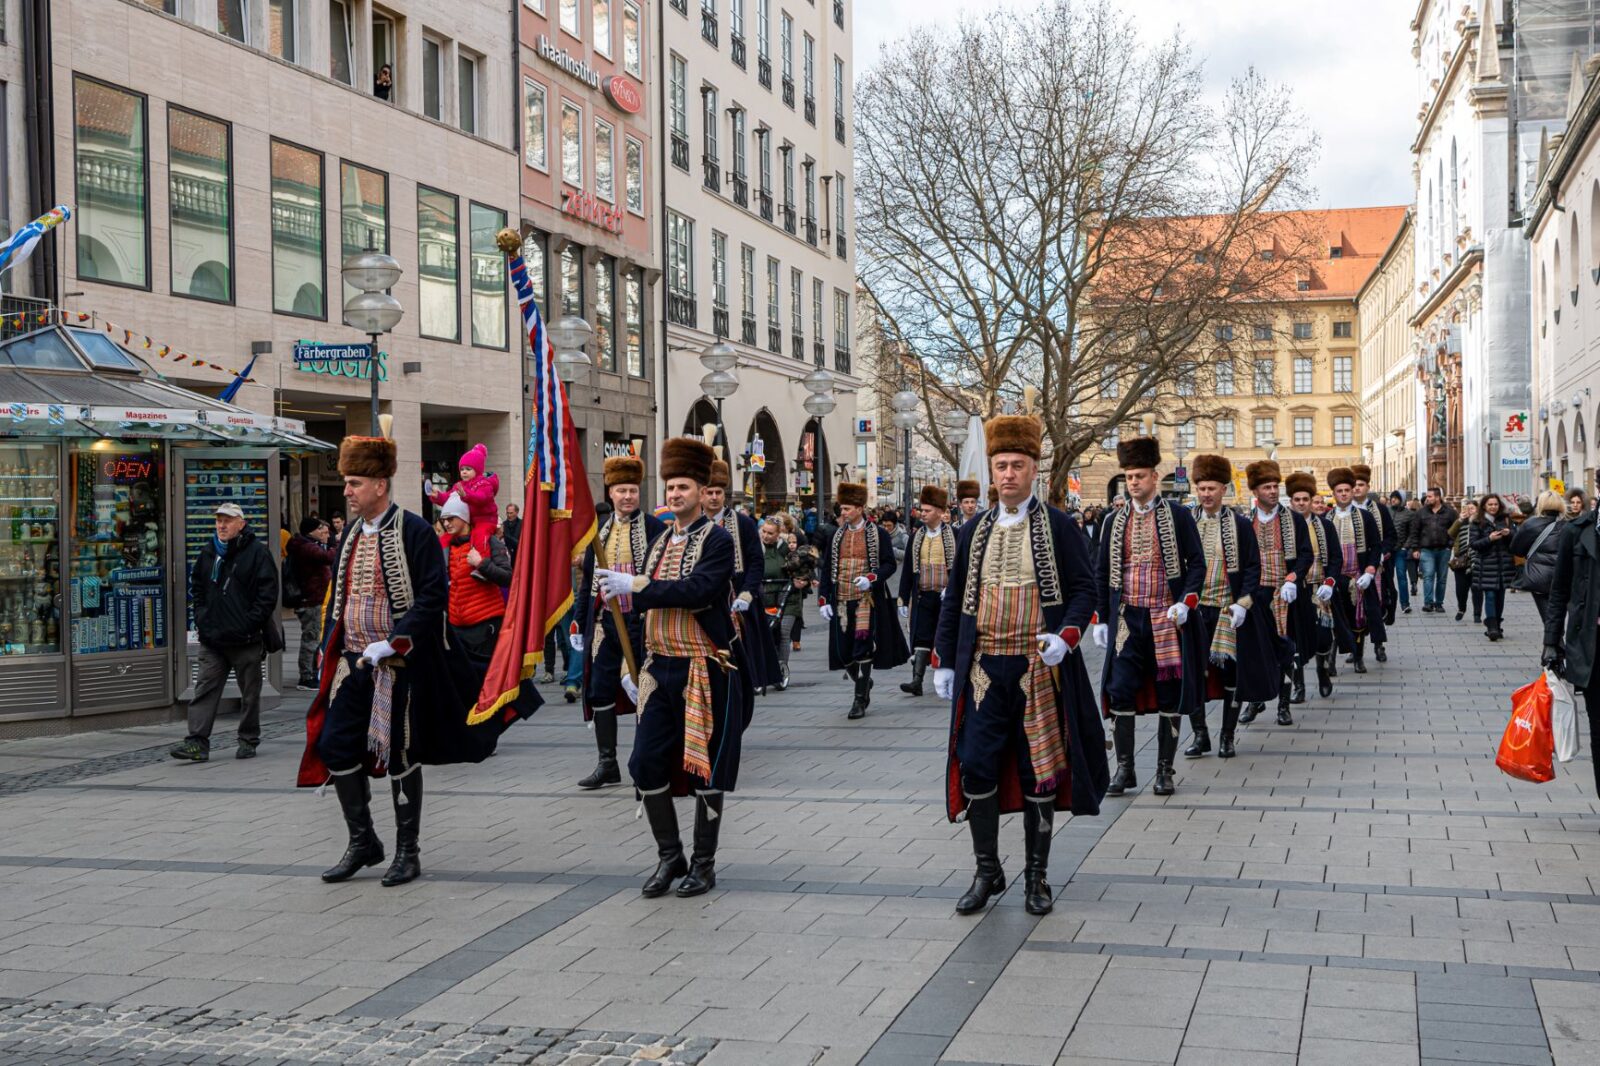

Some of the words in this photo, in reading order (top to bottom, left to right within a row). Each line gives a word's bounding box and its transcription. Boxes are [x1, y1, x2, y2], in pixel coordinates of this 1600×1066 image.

[539, 34, 600, 89] Haarinstitut
[298, 346, 366, 360] Färbergraben
[125, 411, 167, 420] Magazines
[104, 461, 150, 477] OPEN
